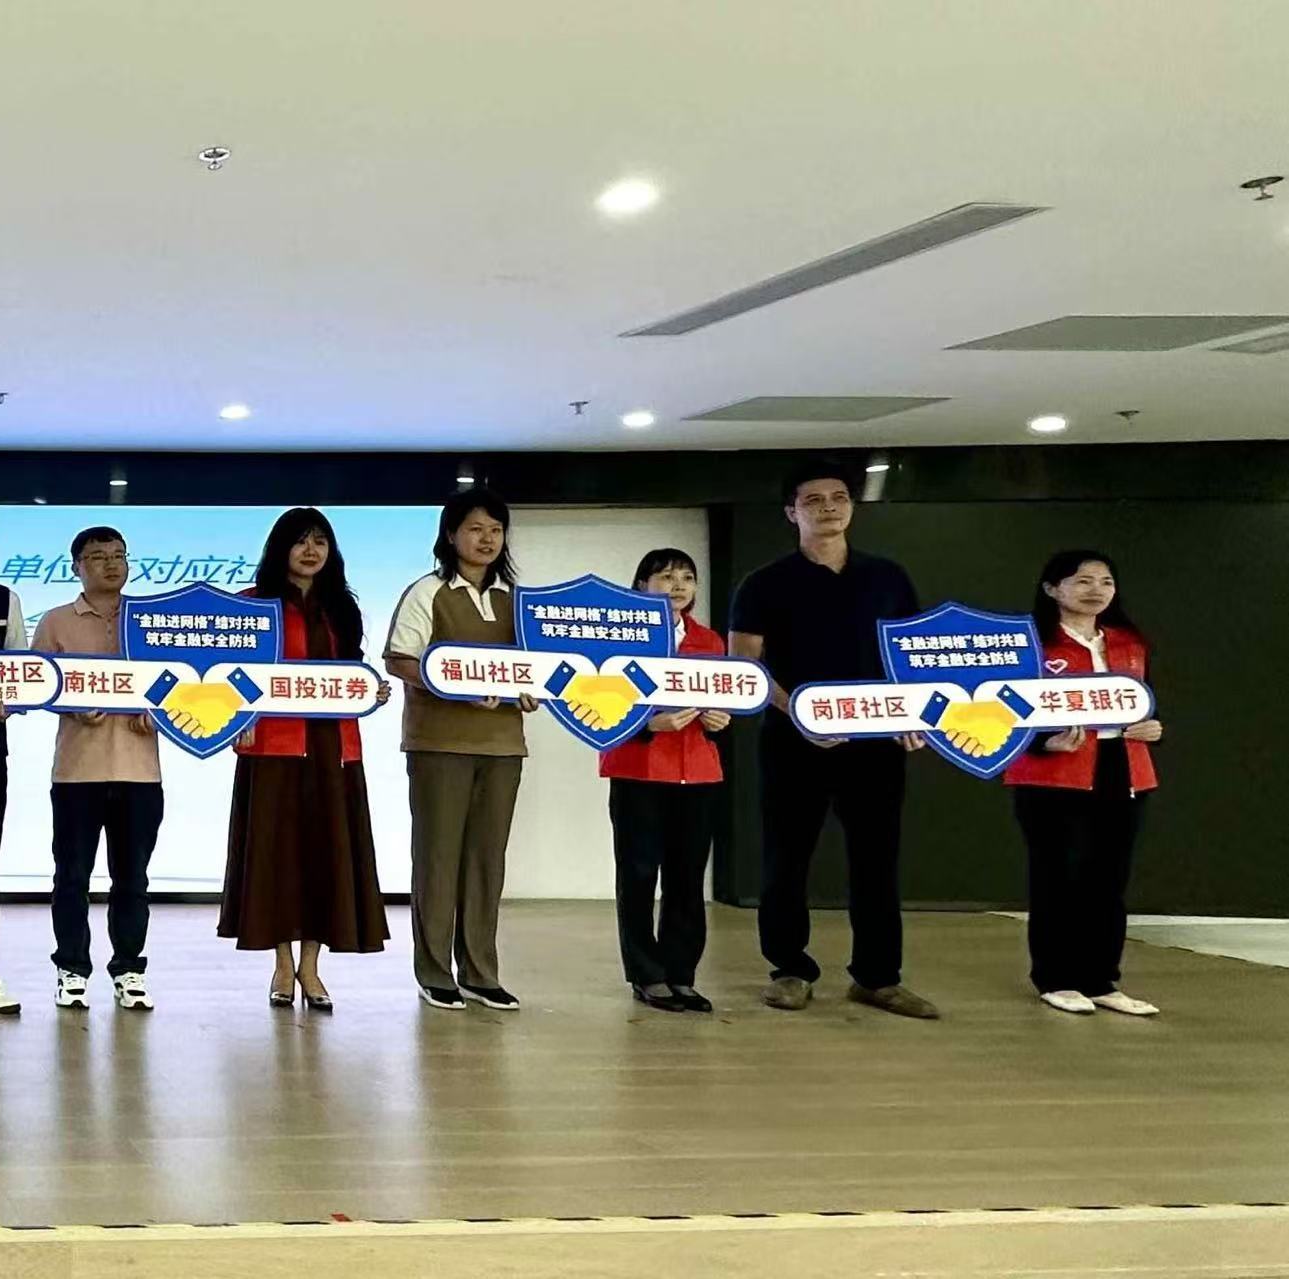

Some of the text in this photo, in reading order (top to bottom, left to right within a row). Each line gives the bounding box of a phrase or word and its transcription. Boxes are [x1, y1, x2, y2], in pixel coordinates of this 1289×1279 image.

[133, 614, 270, 630] “金融进网格”结对共建
[528, 605, 661, 625] “金融进网格”结对共建
[146, 632, 256, 648] 筑牢金融安全防线
[542, 623, 651, 642] 筑牢金融安全防线
[893, 633, 1028, 650] “金融进网格”结对共建
[909, 652, 1019, 667] 筑牢金融安全防线
[441, 658, 534, 684] 福山社区
[270, 676, 368, 699] 国投证券
[664, 671, 757, 696] 玉山银行
[812, 696, 908, 720] 岗厦社区
[1039, 689, 1137, 712] 华夏银行
